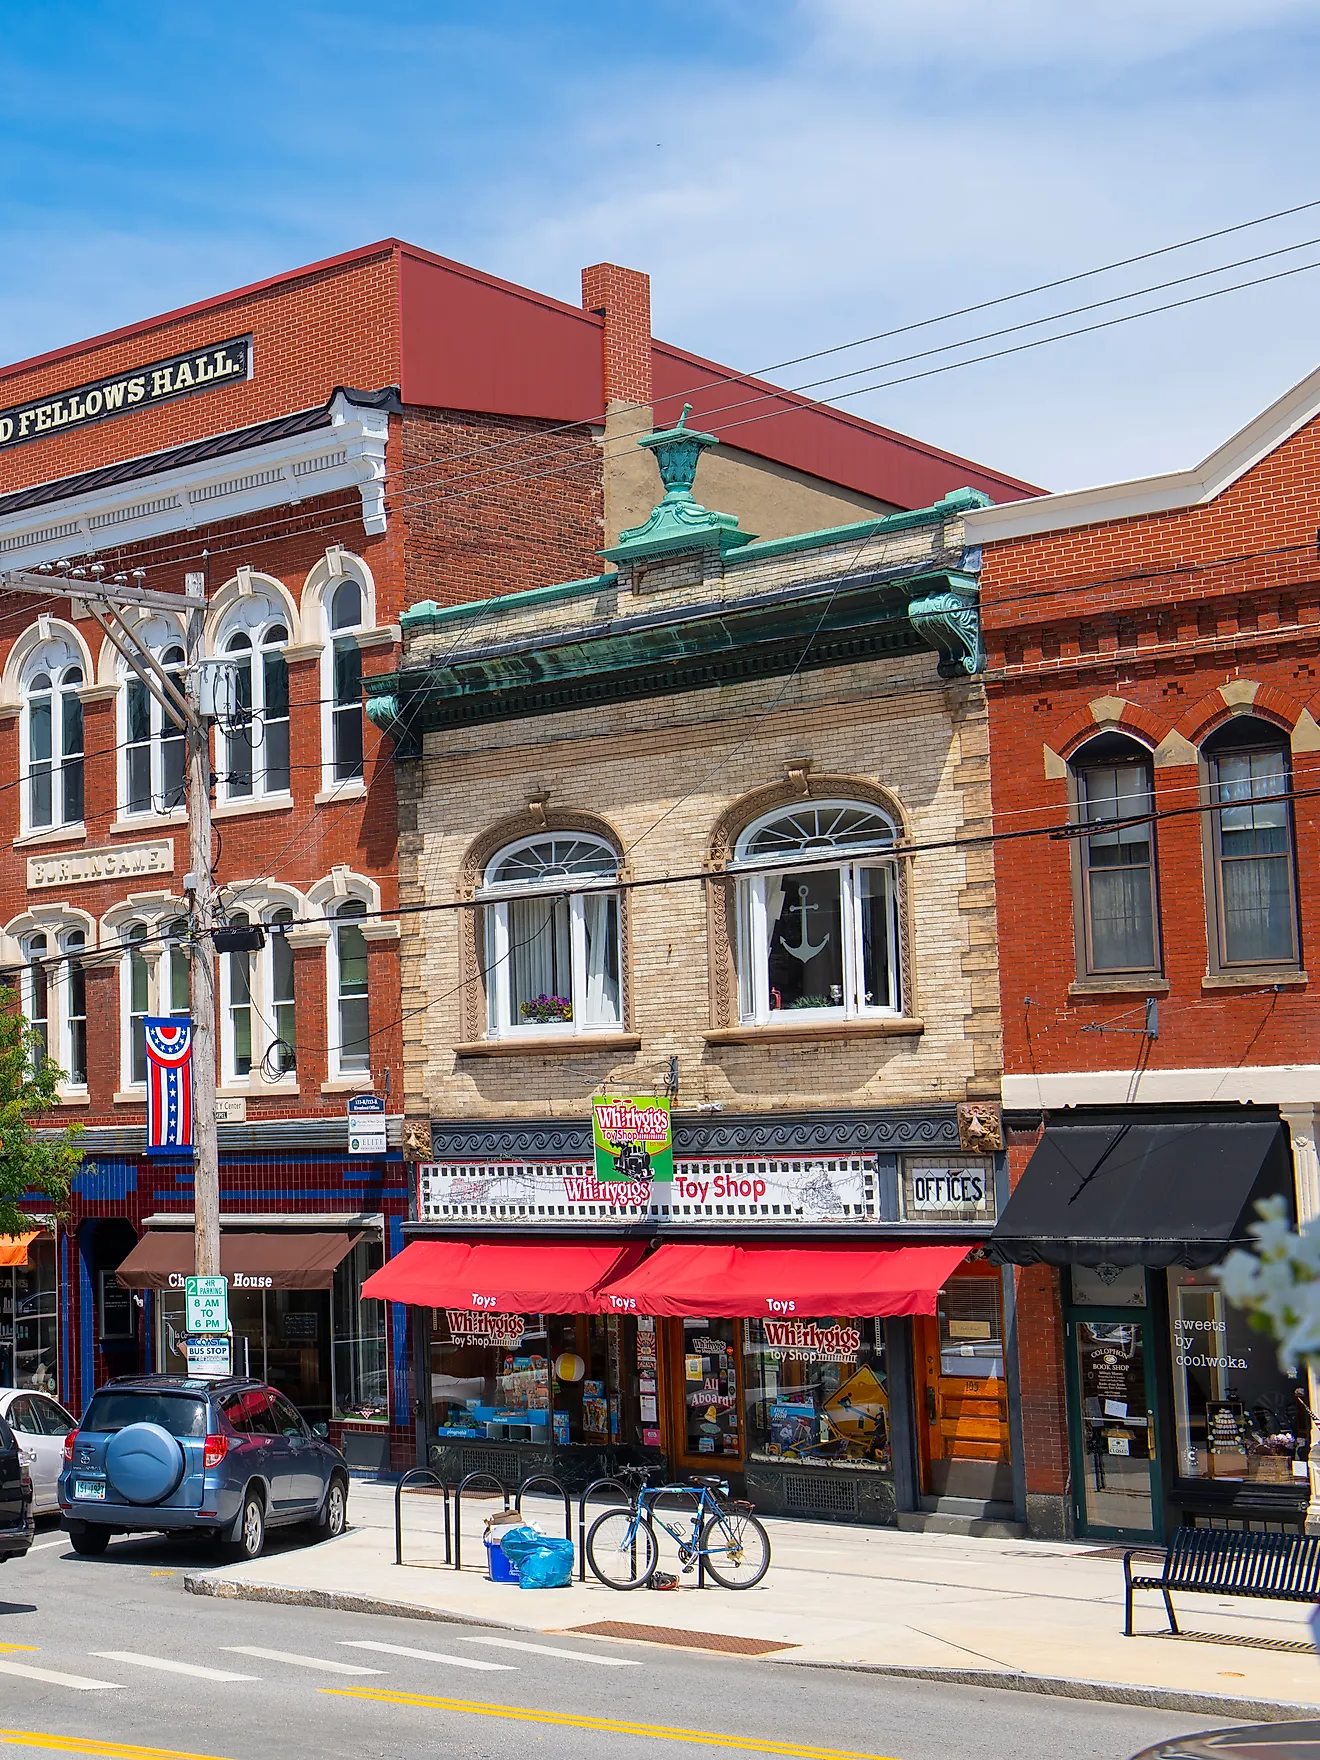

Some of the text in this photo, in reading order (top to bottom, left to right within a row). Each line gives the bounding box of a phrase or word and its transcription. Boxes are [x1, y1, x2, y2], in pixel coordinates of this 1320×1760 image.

[18, 376, 145, 437] FELLOWS
[594, 1105, 669, 1136] Whirlygigs
[362, 1138, 383, 1146] ELITE
[602, 1130, 638, 1142] Toy Shop
[564, 1174, 766, 1207] Whirlygigs Toy Shop
[915, 1176, 983, 1201] OFFICES
[187, 1279, 197, 1295] 2
[232, 1272, 273, 1288] House
[199, 1287, 223, 1295] PARKING
[194, 1299, 220, 1308] 8 AM
[471, 1293, 497, 1308] Toys
[610, 1295, 637, 1311] Toys
[766, 1298, 796, 1314] Toys
[200, 1309, 214, 1317] TO
[194, 1319, 220, 1328] 6 PM
[446, 1310, 525, 1339] Whirlygigs
[1174, 1318, 1226, 1332] sweets
[195, 1338, 220, 1346] COAST
[450, 1334, 490, 1348] Toy Shop
[764, 1321, 861, 1355] Whirlygigs
[1174, 1334, 1194, 1349] by
[189, 1347, 227, 1355] BUS STOP
[769, 1349, 817, 1364] Toy Shop
[1090, 1347, 1130, 1360] COLOPHON
[1092, 1363, 1130, 1372] BOOK SHOP
[1175, 1353, 1248, 1369] coolwoka
[703, 1377, 719, 1391] All
[965, 1381, 979, 1392] 105
